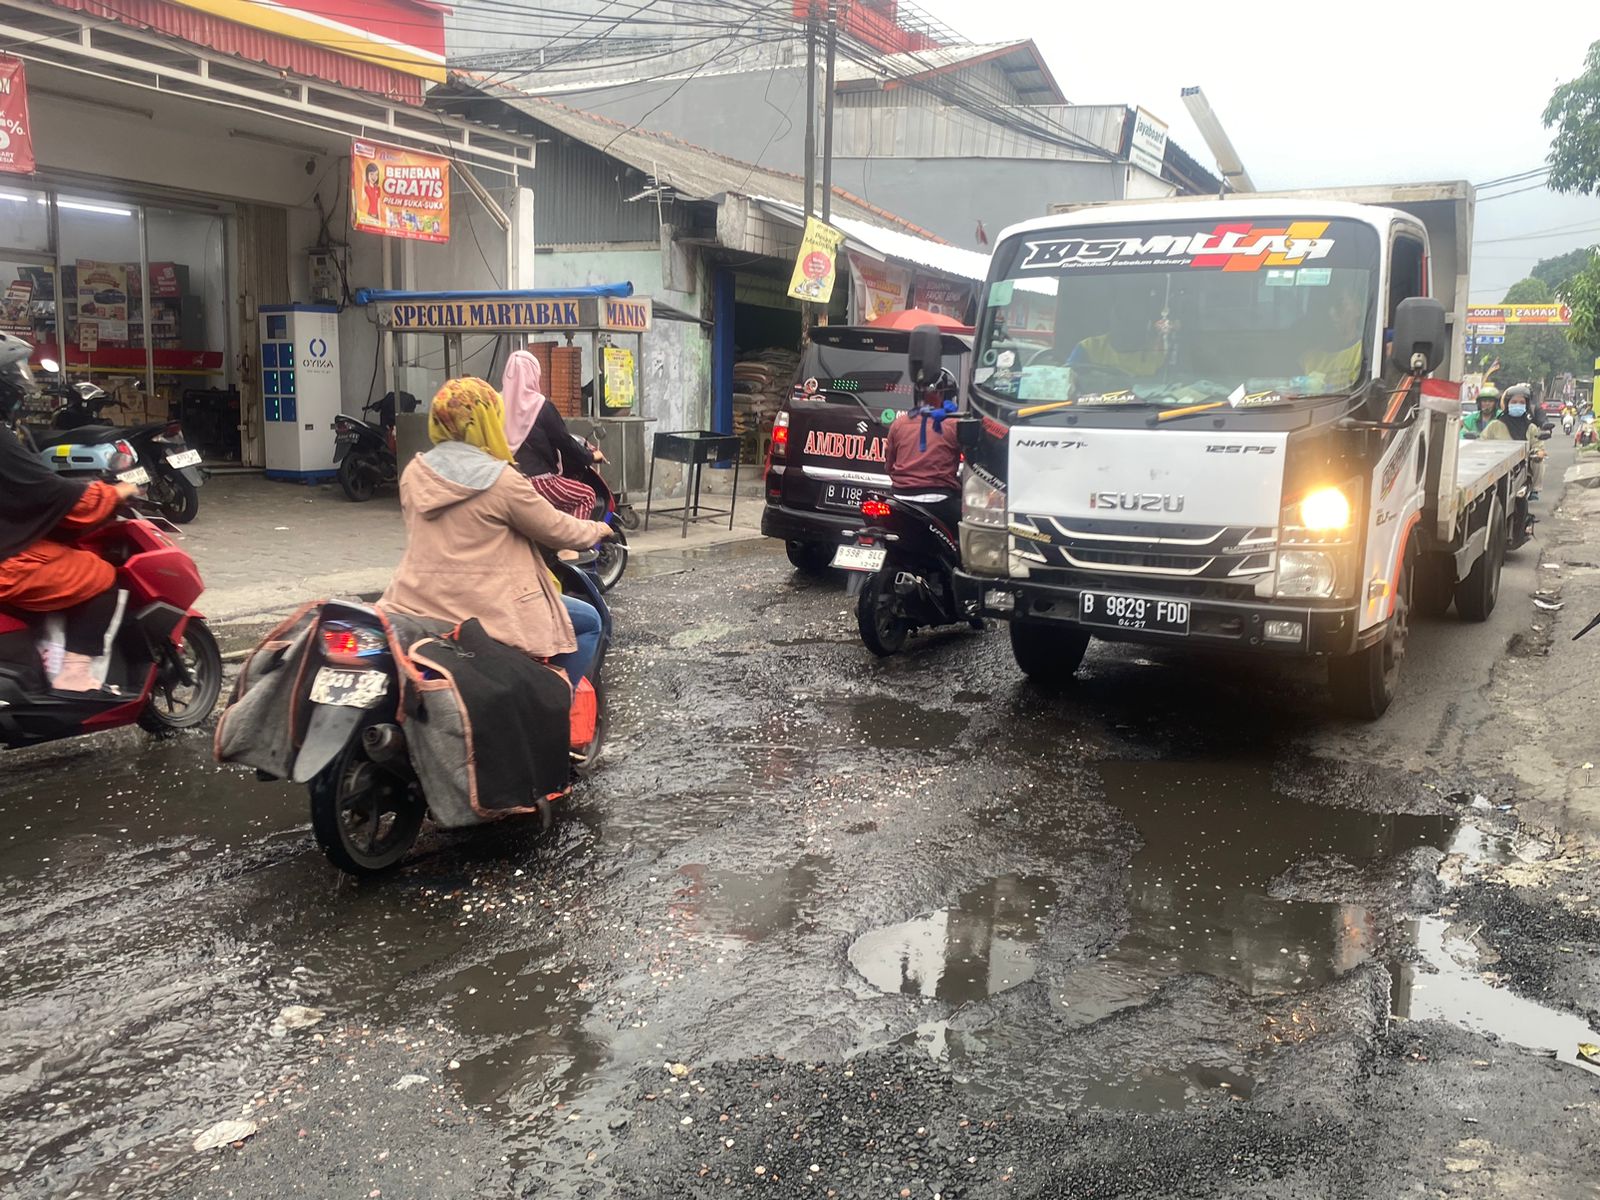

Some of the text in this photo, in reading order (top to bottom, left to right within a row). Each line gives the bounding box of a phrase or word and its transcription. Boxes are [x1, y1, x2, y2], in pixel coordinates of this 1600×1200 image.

[386, 166, 440, 179] BENERAN
[384, 178, 443, 198] GRATIS
[384, 197, 402, 206] PILIH
[1020, 232, 1335, 269] BISMILLAH
[393, 303, 646, 327] SPECIAL MARTABAK MANIS
[1206, 445, 1277, 454] 125 PS
[828, 485, 835, 497] B
[1090, 492, 1184, 512] ISUZU
[1084, 594, 1187, 623] B 9829 FDD
